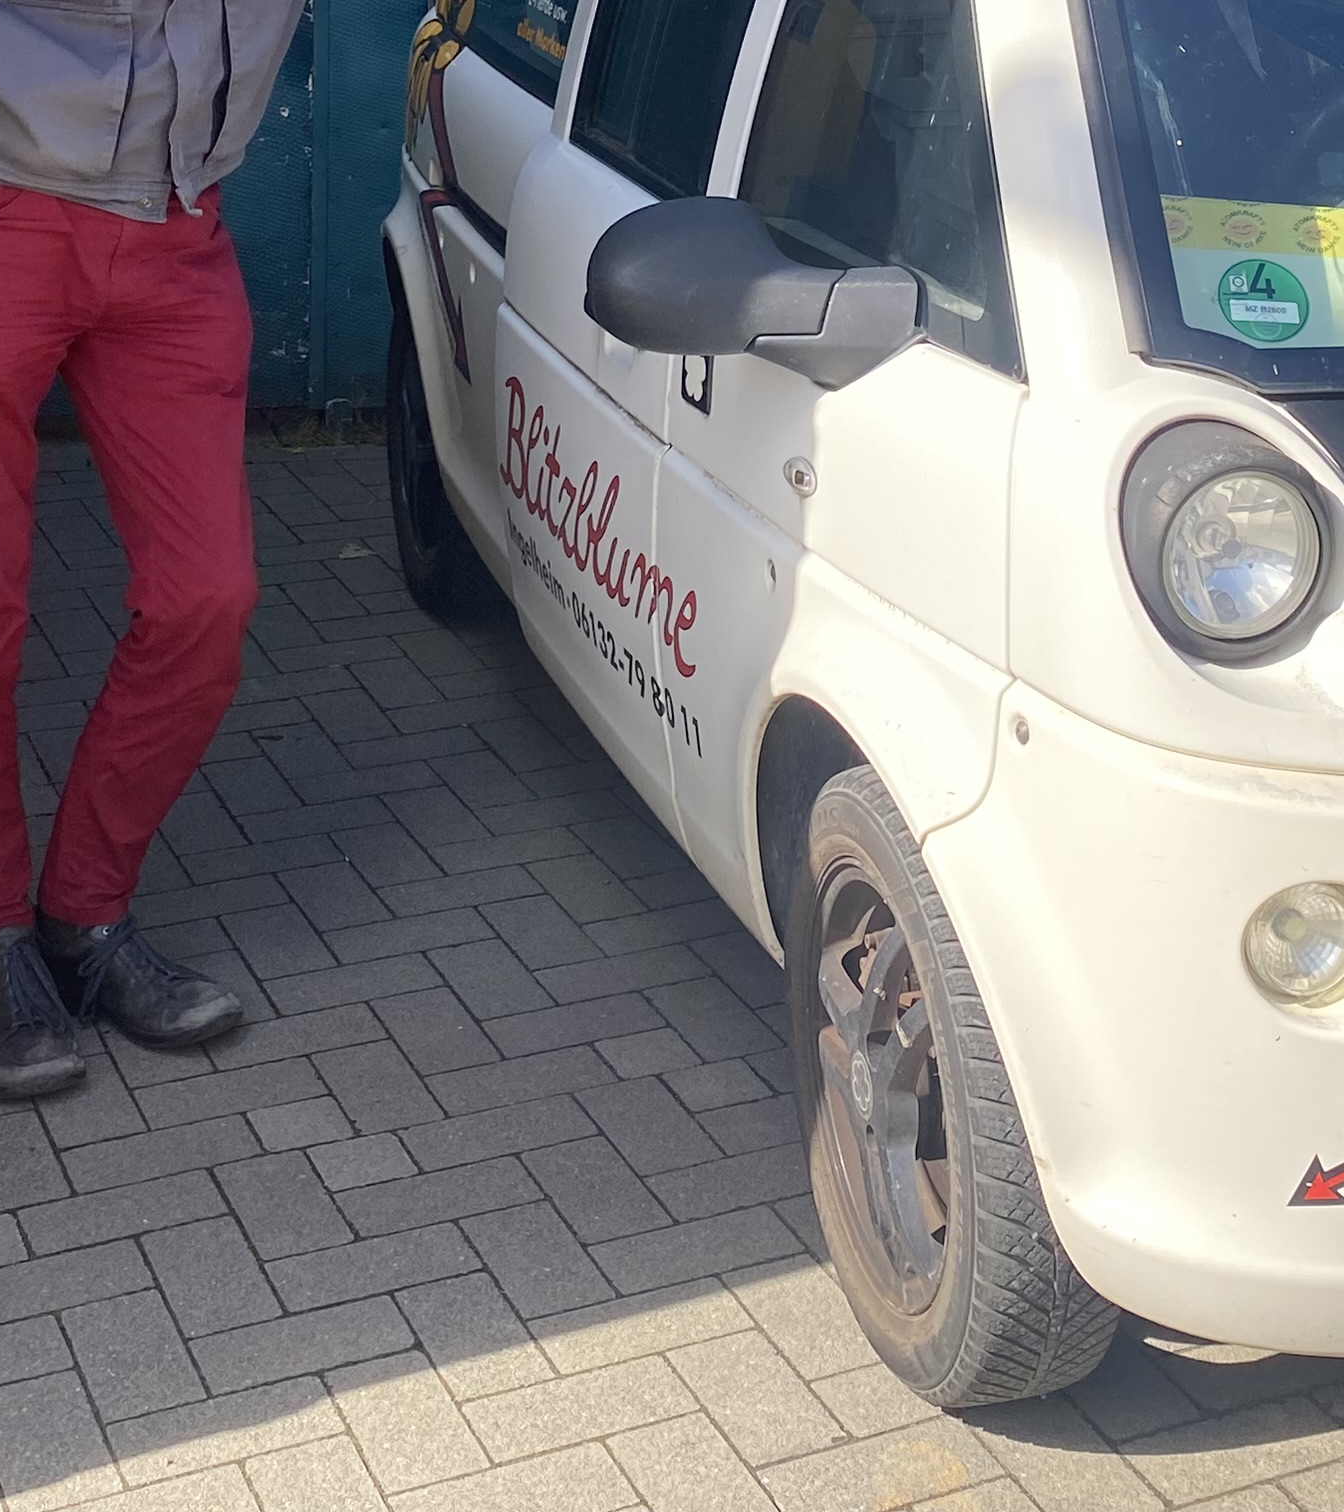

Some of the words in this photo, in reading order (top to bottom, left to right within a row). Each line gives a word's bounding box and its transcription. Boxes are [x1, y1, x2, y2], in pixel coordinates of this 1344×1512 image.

[552, 4, 568, 24] usw.
[533, 26, 566, 60] Marken
[1292, 215, 1340, 232] ATOMKRAFT?
[1170, 226, 1194, 244] DANKE
[1296, 240, 1316, 254] NEIN
[1249, 262, 1276, 300] 4
[1245, 304, 1259, 313] MZ
[500, 376, 697, 678] Blitzblume
[507, 506, 567, 611] Ingelheim
[571, 590, 646, 699] 06132-79
[650, 675, 676, 729] 80
[681, 704, 703, 759] 11
